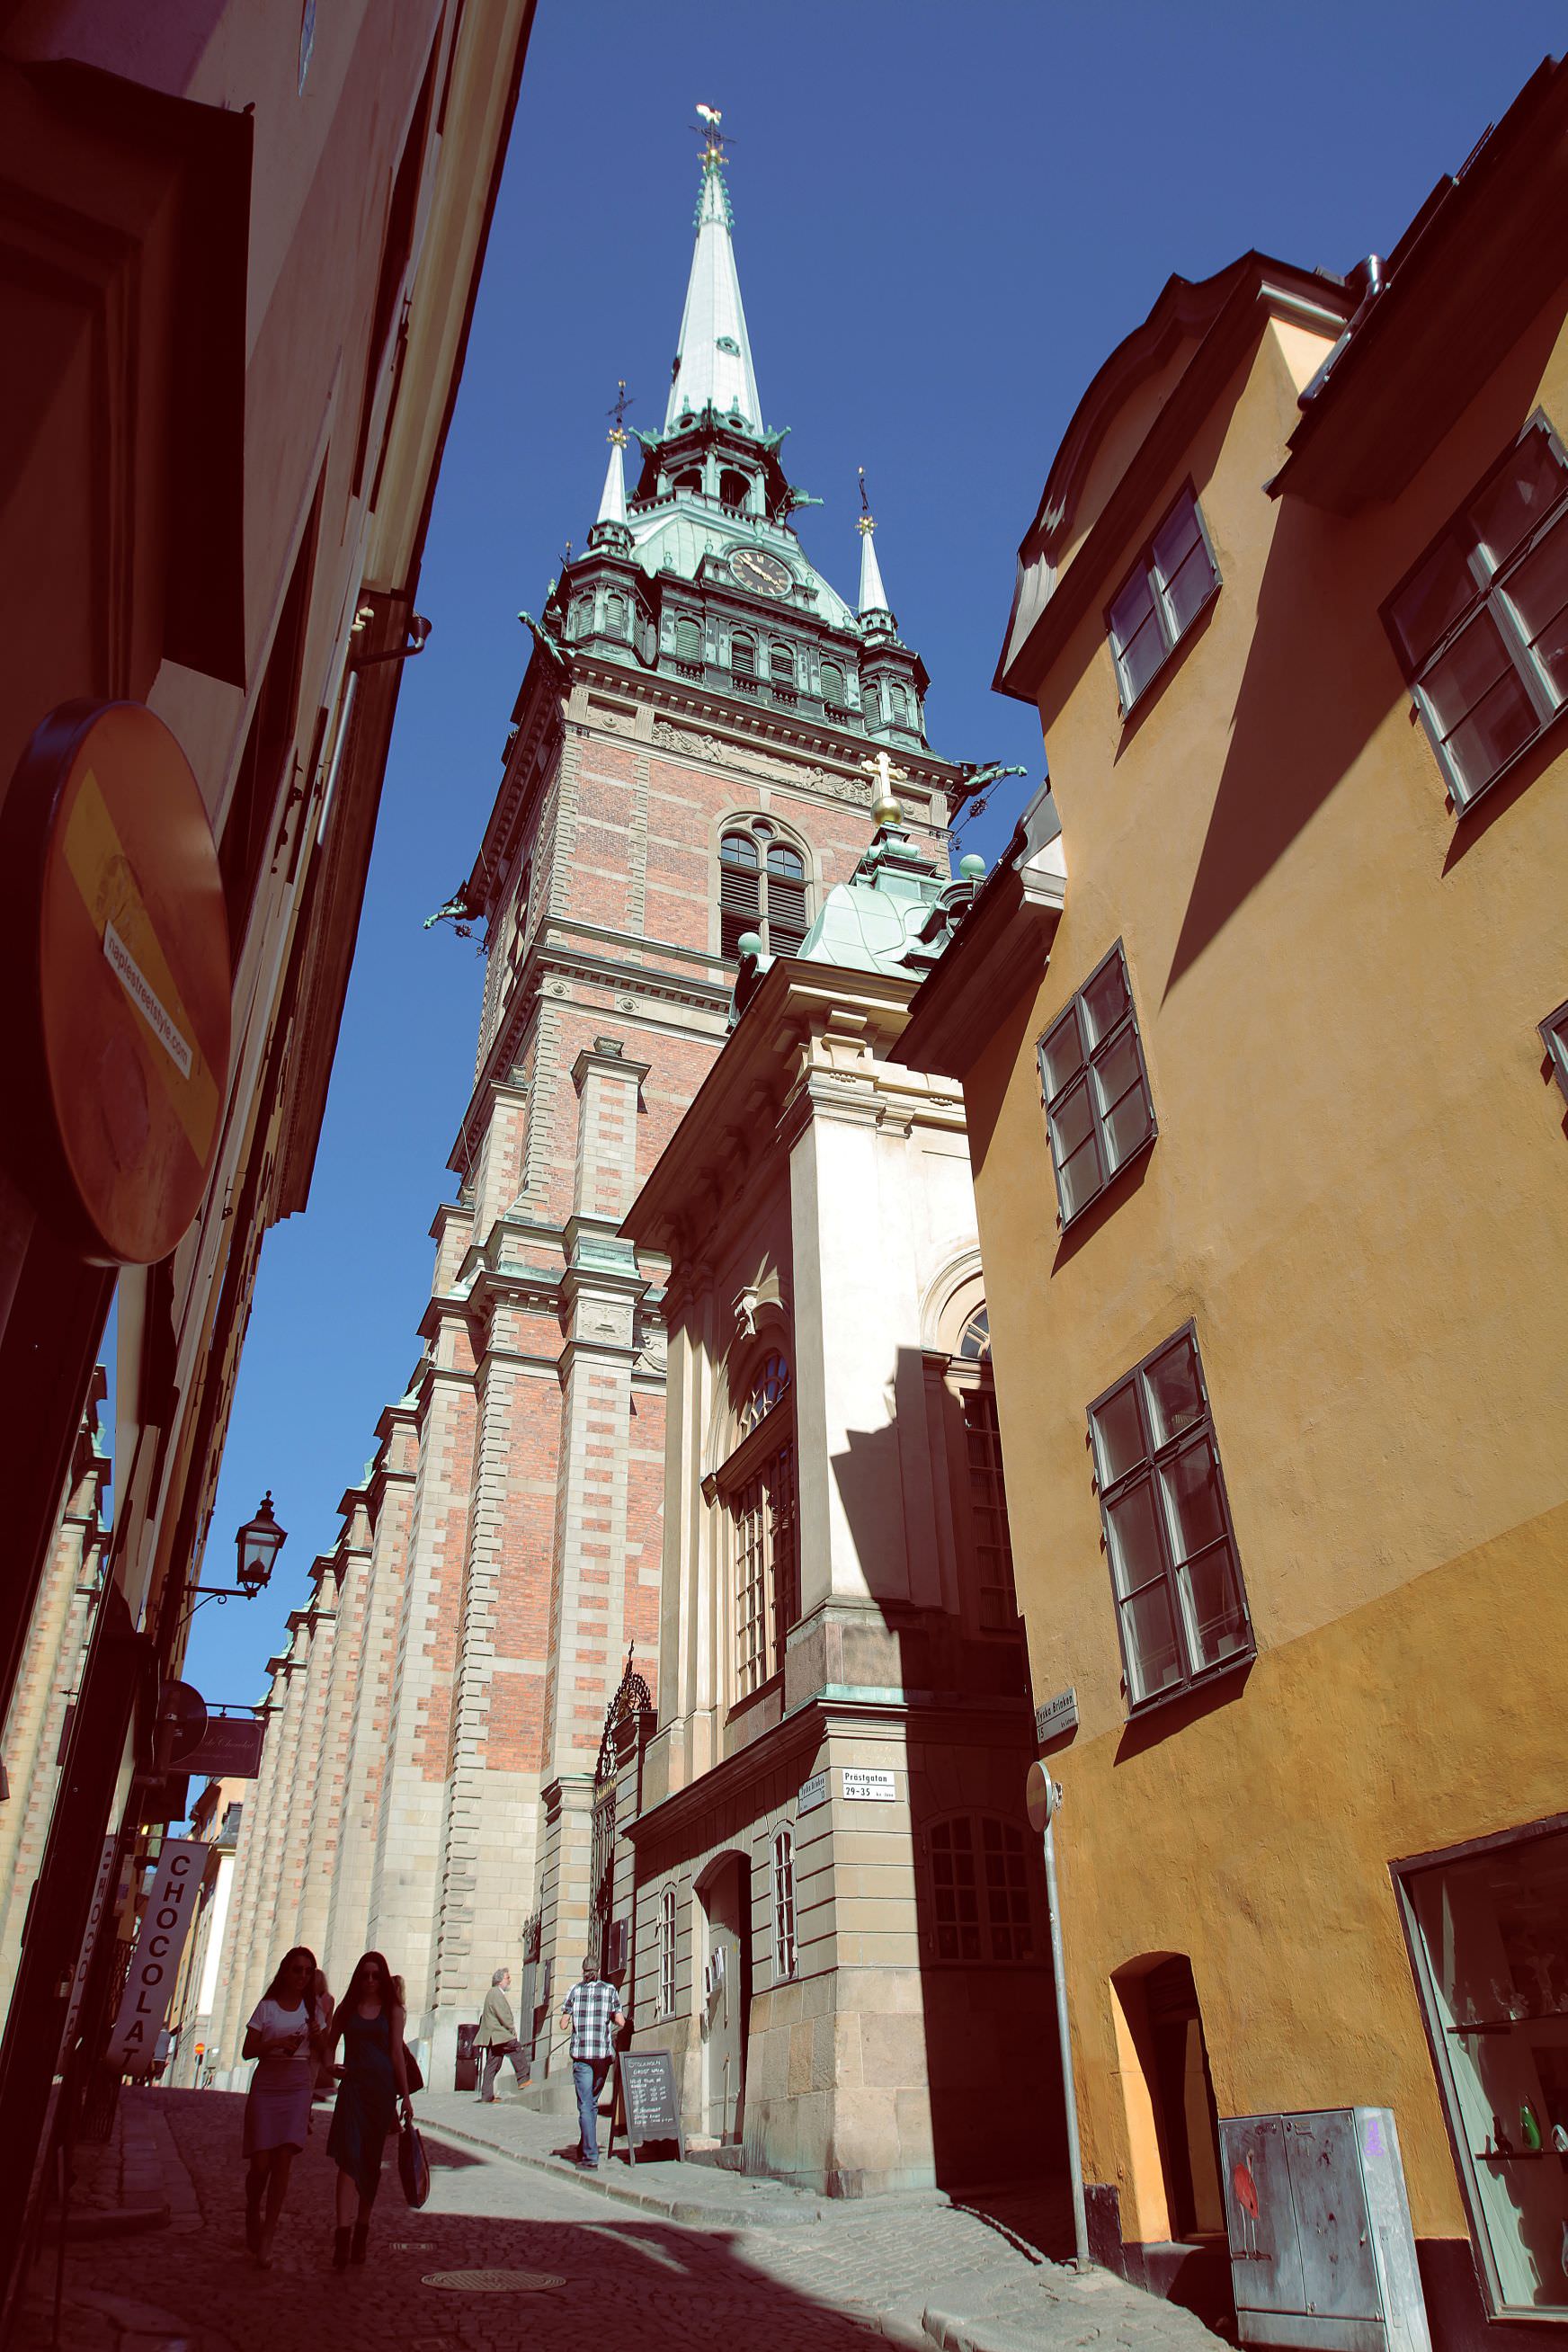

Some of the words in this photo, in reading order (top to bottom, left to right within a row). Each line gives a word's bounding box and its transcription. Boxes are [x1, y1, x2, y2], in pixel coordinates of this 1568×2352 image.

[109, 940, 189, 1065] naplestreetstyle.com
[1037, 1708, 1051, 1723] Tyska
[1053, 1696, 1073, 1712] Brinken
[1038, 1726, 1045, 1741] 15
[844, 1772, 887, 1783] Prästgatan
[845, 1786, 870, 1796] 29-35
[121, 1855, 191, 2068] CHOCOLAT
